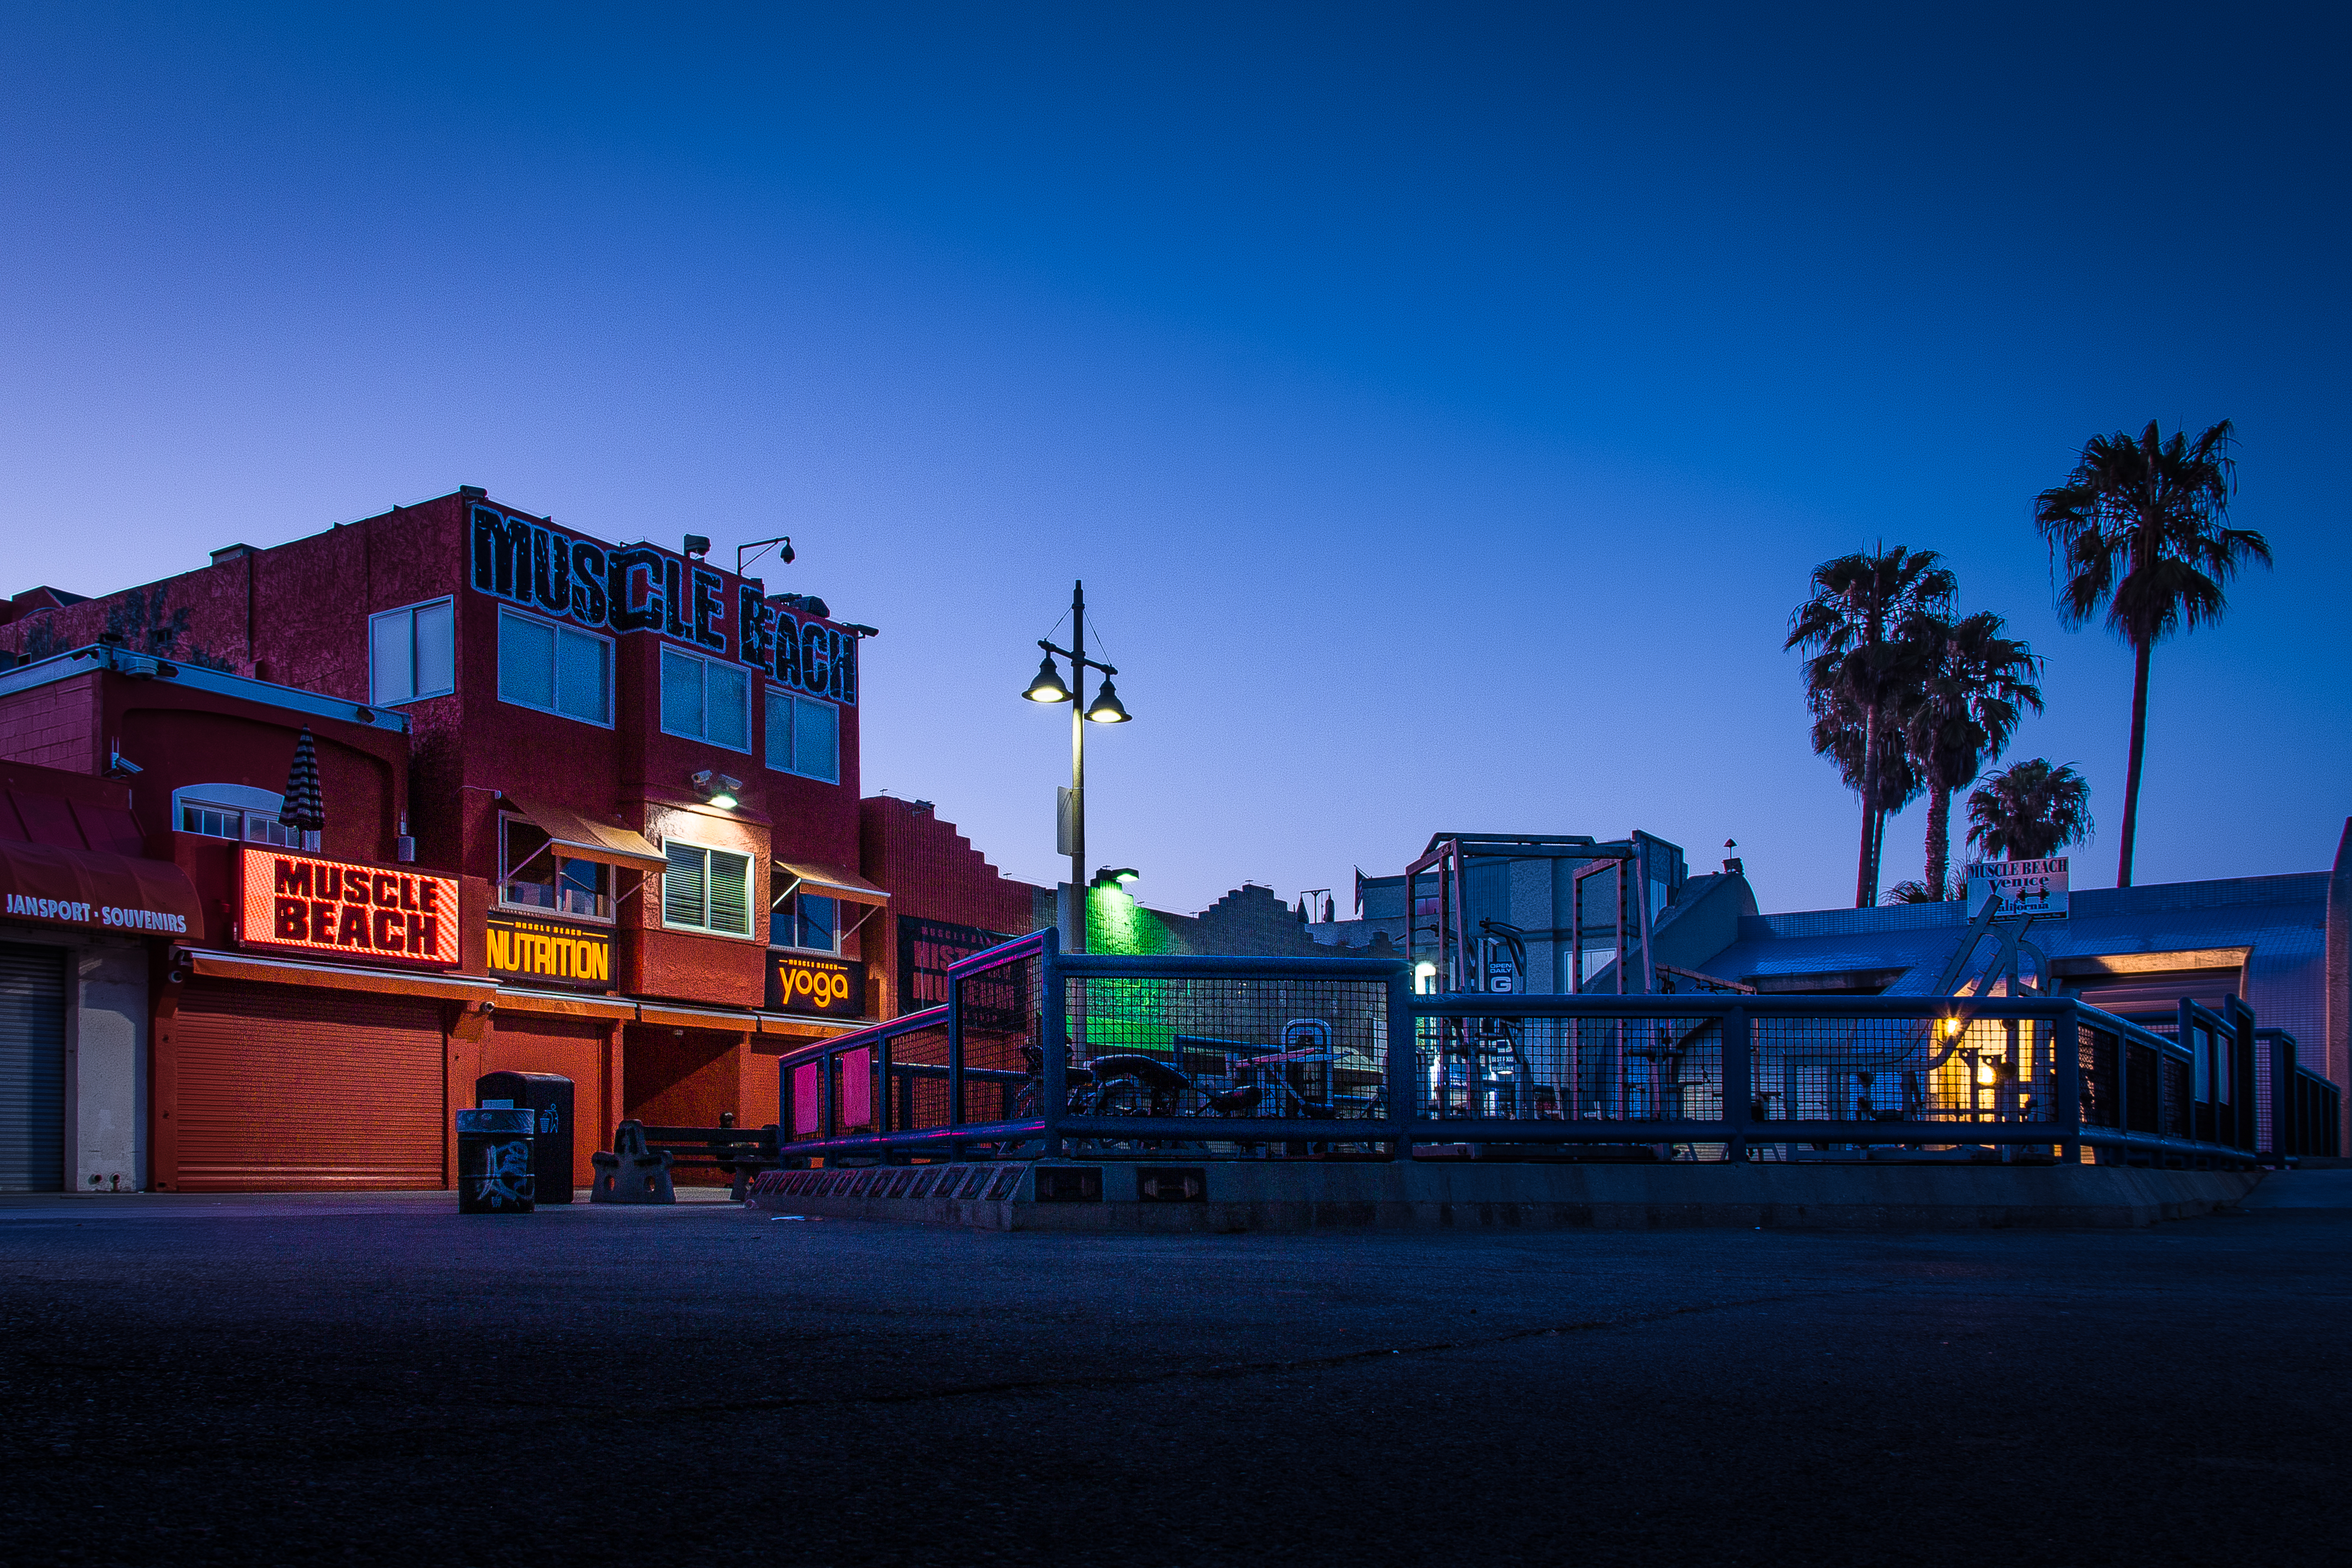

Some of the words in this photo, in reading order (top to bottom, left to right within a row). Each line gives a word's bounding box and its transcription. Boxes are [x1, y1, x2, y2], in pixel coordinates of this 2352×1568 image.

[471, 504, 726, 652] MUSCLE
[739, 584, 856, 707] BEACH
[1969, 862, 2019, 878] MUSCLE
[2022, 859, 2067, 874] BEACH
[275, 860, 436, 913] MUSCLE
[1988, 876, 2049, 894] Venice
[6, 894, 91, 922] JANSPORT
[102, 906, 187, 933] SOUVENIRS
[1998, 899, 2049, 914] alifornia
[275, 897, 436, 955] BEACH
[515, 922, 550, 932] MUSCLE
[553, 927, 582, 937] BEACH
[486, 928, 608, 981] NUTRITION
[789, 959, 814, 968] MUSCLE
[779, 967, 848, 1008] yoga
[1491, 977, 1511, 992] G
